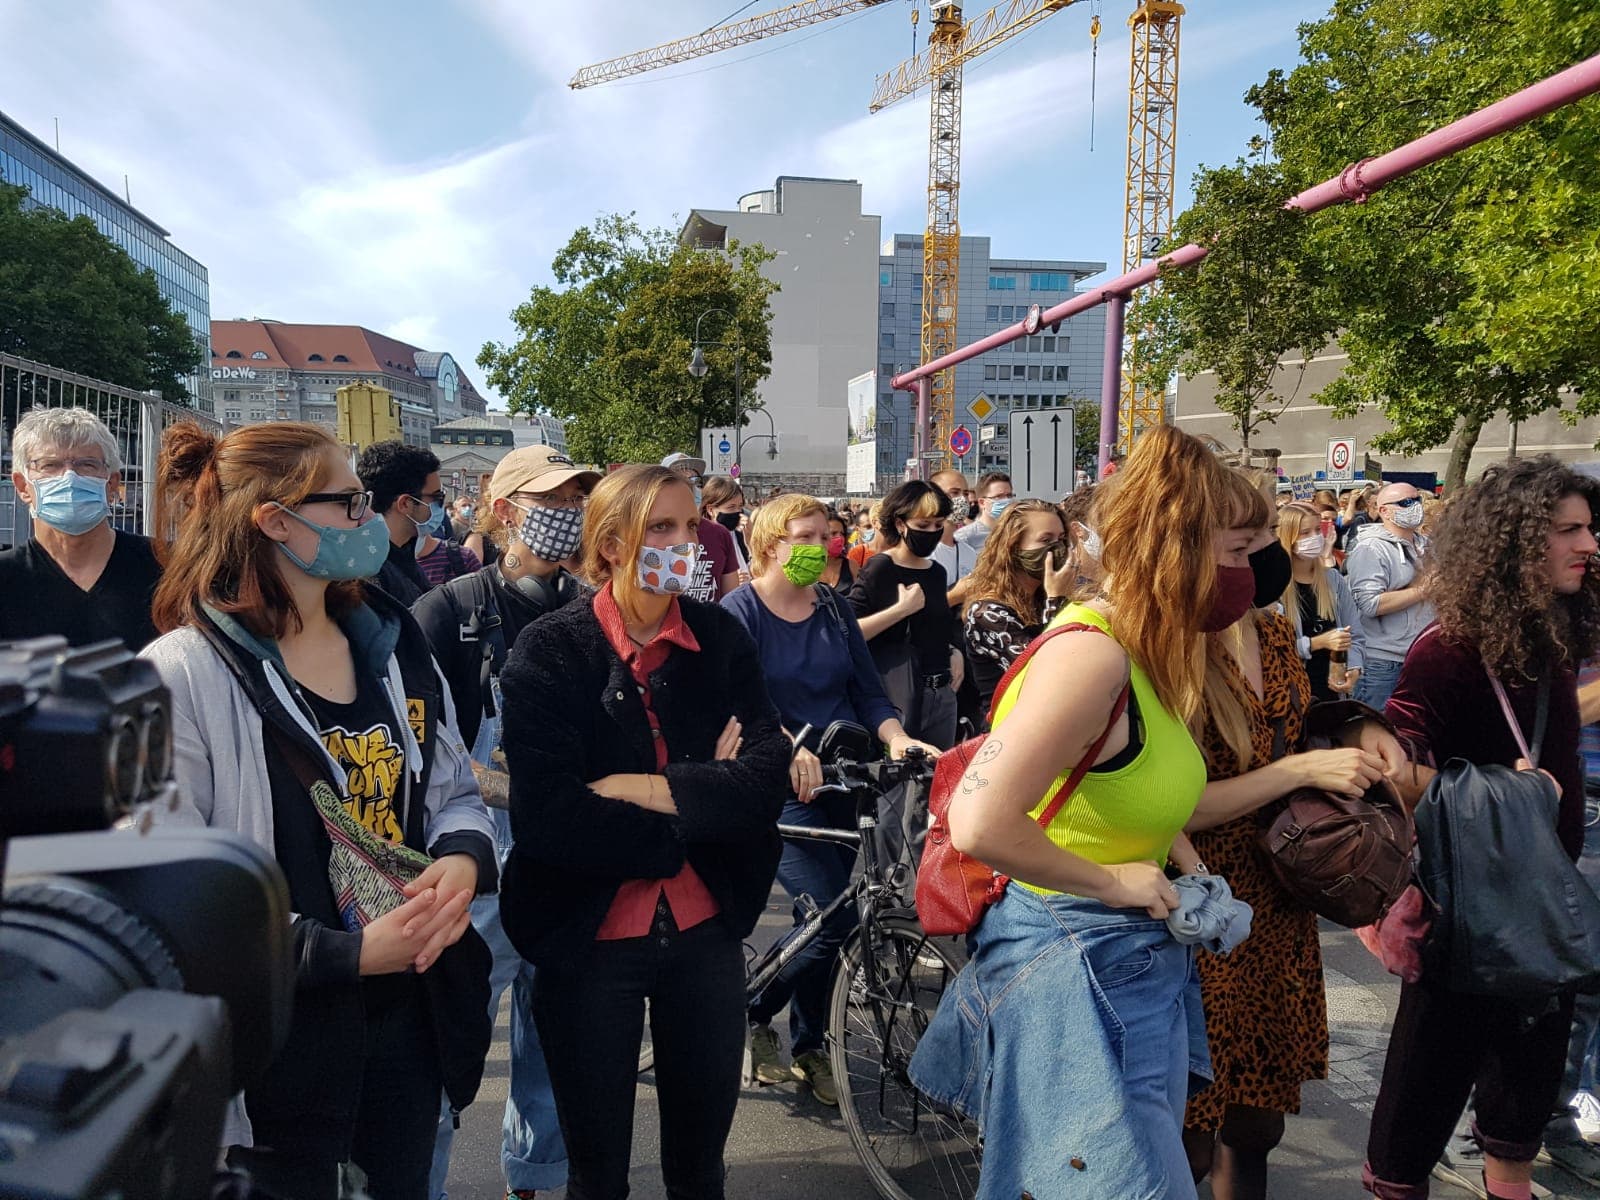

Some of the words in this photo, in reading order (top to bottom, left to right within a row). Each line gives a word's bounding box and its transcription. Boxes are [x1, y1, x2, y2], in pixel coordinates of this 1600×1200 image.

[1129, 239, 1136, 255] 2
[1151, 237, 1160, 252] 2
[212, 366, 257, 379] aDeWe
[1336, 450, 1346, 462] 30
